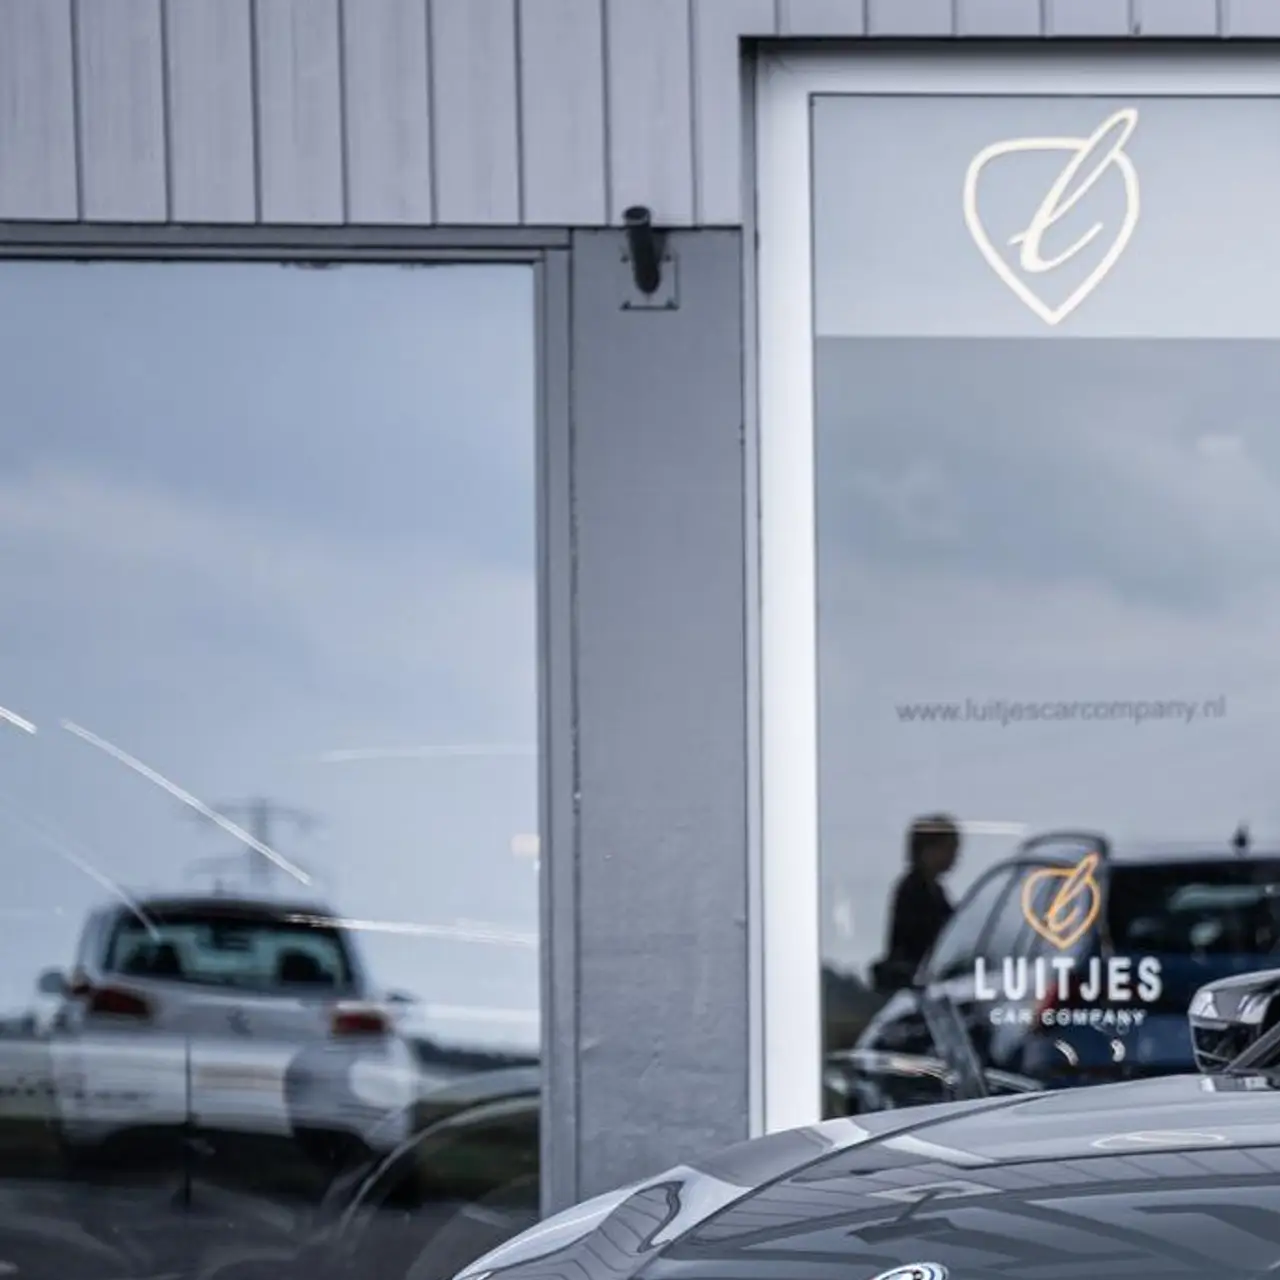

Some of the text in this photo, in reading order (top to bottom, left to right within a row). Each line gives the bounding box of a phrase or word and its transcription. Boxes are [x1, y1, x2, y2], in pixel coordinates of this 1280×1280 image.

[895, 696, 1227, 728] www.luitjescarcompany.nl
[974, 956, 1163, 1002] LUITJES
[989, 1007, 1148, 1027] CAR COMPANY
